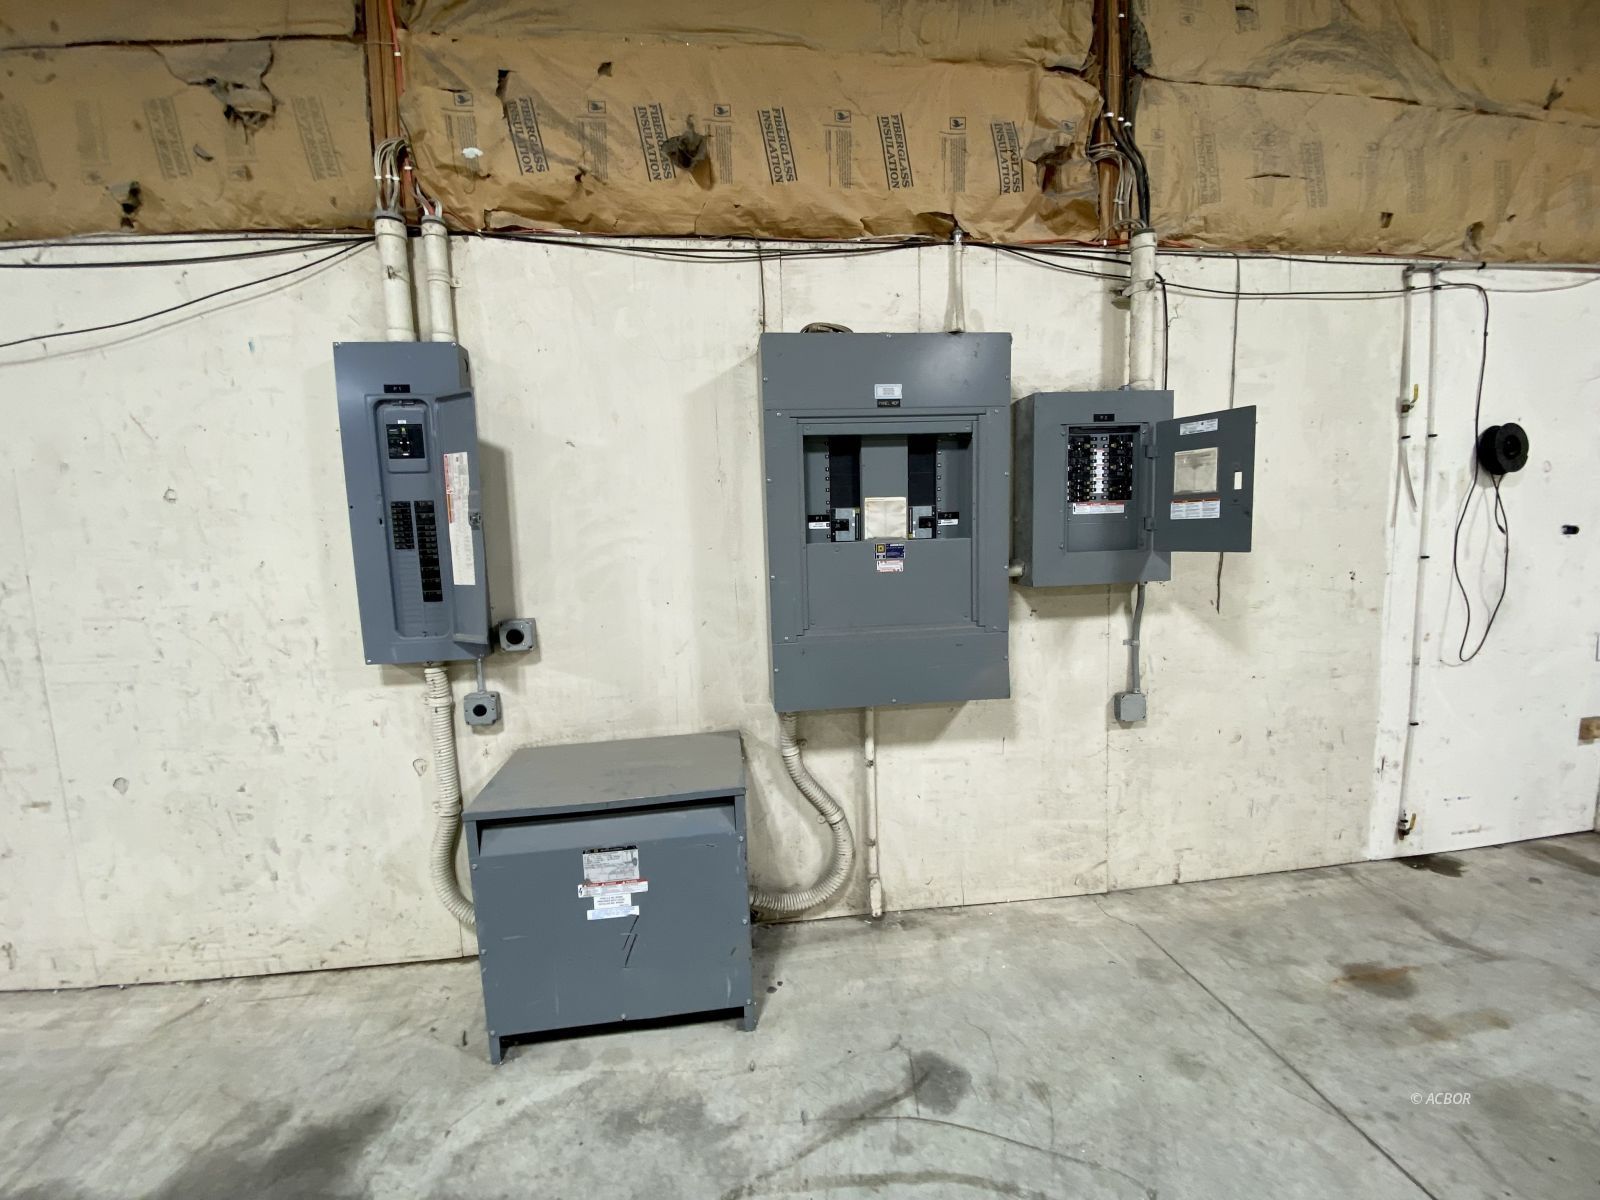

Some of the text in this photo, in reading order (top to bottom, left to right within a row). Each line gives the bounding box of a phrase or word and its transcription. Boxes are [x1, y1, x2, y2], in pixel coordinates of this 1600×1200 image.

[507, 100, 534, 174] INSULATION
[518, 97, 546, 173] FIBERGLASS
[637, 106, 662, 181] INSULATION
[648, 104, 673, 180] FIBERGASS
[761, 109, 784, 183] INSULATION
[771, 107, 795, 182] FIBERGLASS
[881, 116, 900, 189] INSULATION
[890, 114, 910, 188] FIBERGLASS
[994, 123, 1011, 194] INSULATION
[1004, 121, 1021, 193] FIBERGLASS
